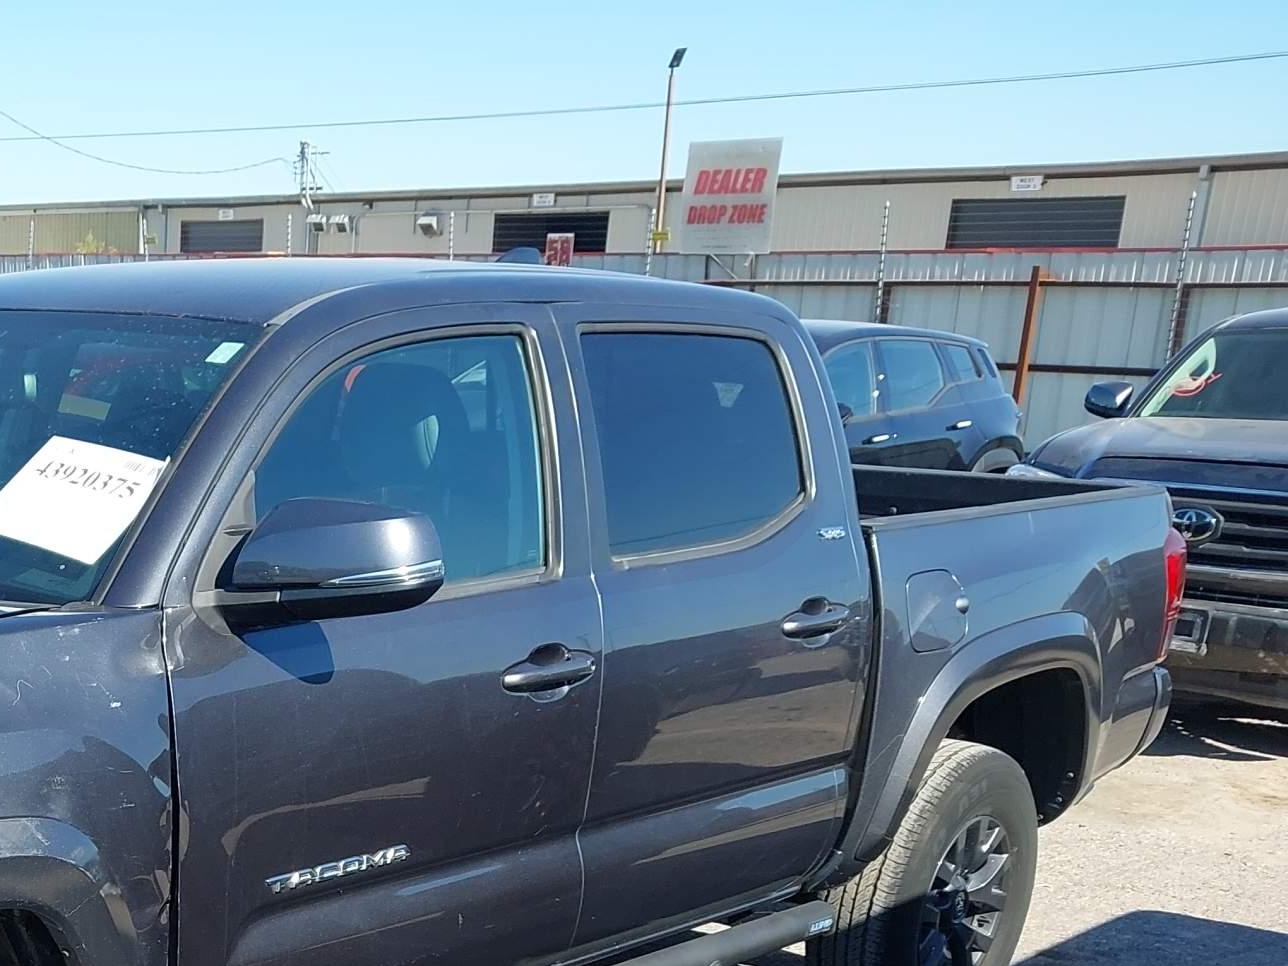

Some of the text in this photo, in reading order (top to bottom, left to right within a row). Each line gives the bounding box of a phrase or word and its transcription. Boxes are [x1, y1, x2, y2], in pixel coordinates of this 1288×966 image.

[694, 168, 768, 195] DEALER
[687, 204, 768, 225] DROP ZONE
[35, 460, 142, 499] 43920375
[265, 844, 411, 895] TACOMA
